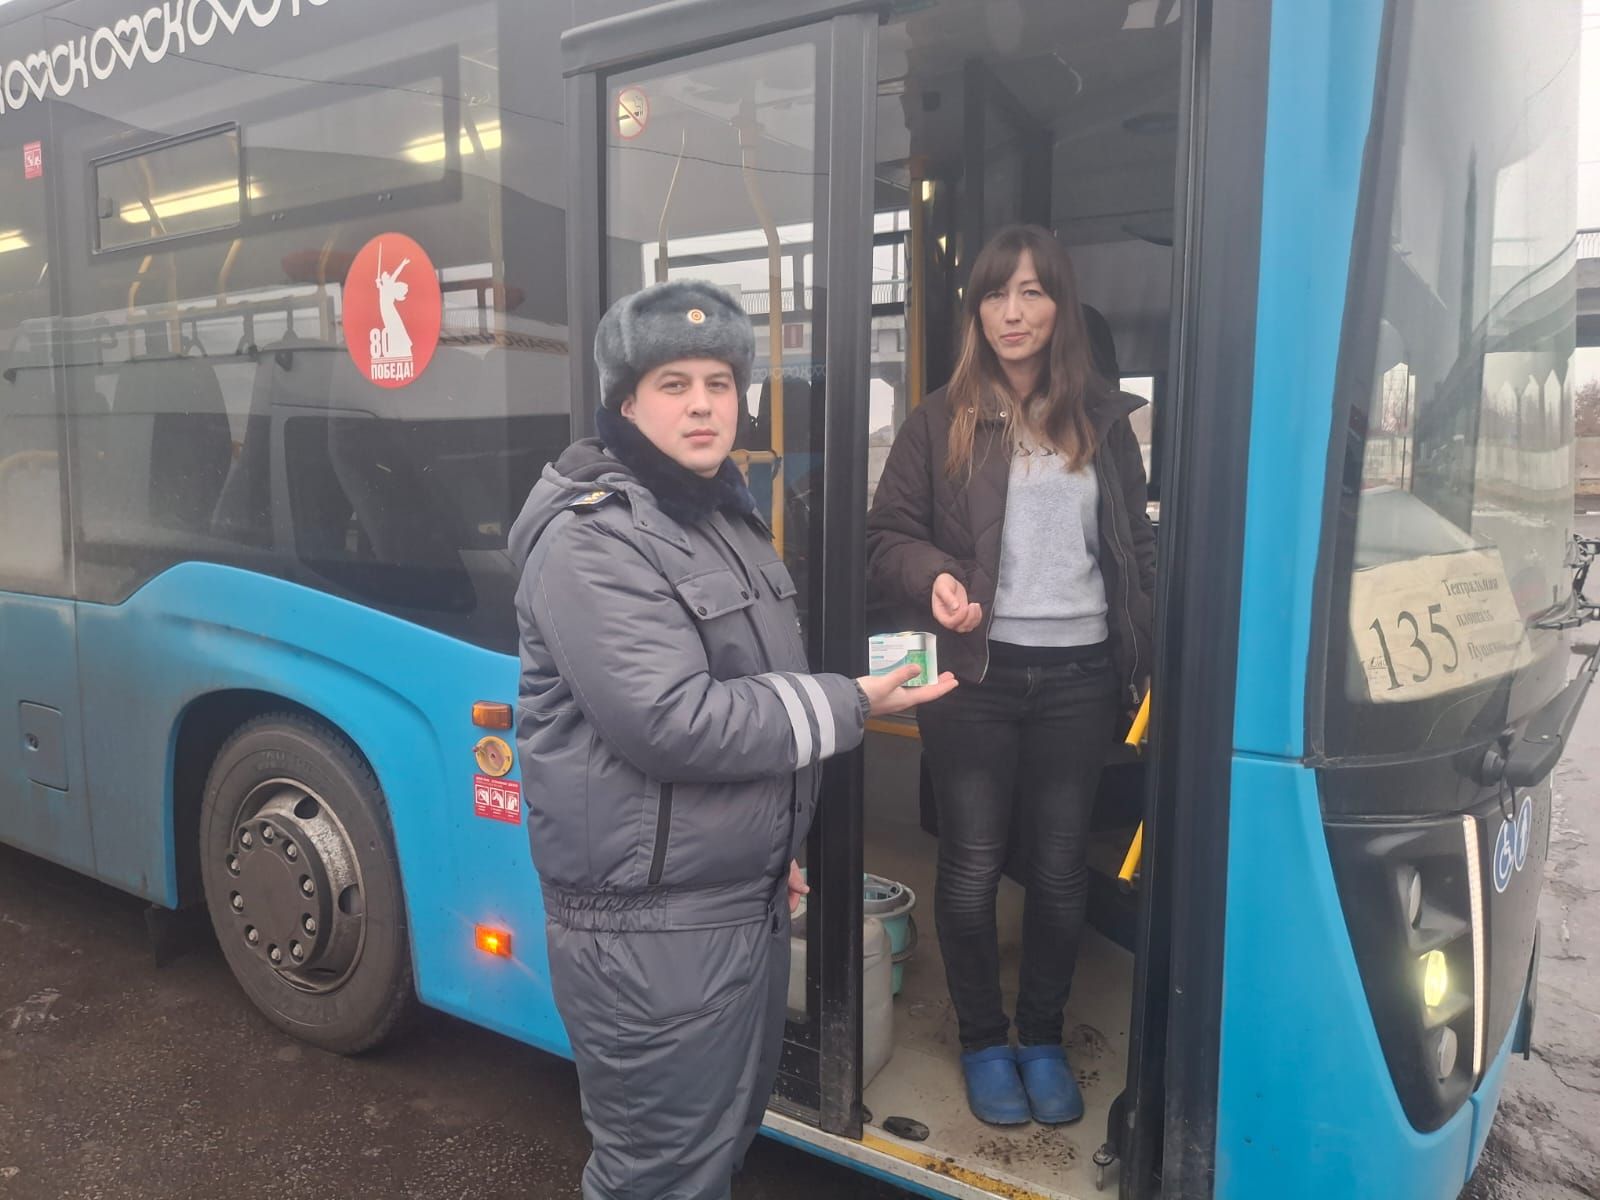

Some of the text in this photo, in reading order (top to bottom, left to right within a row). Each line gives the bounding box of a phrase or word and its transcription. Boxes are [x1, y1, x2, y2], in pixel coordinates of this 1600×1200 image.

[369, 328, 392, 358] 80
[371, 362, 414, 381] ПОБЕДА!
[1368, 603, 1459, 691] 135
